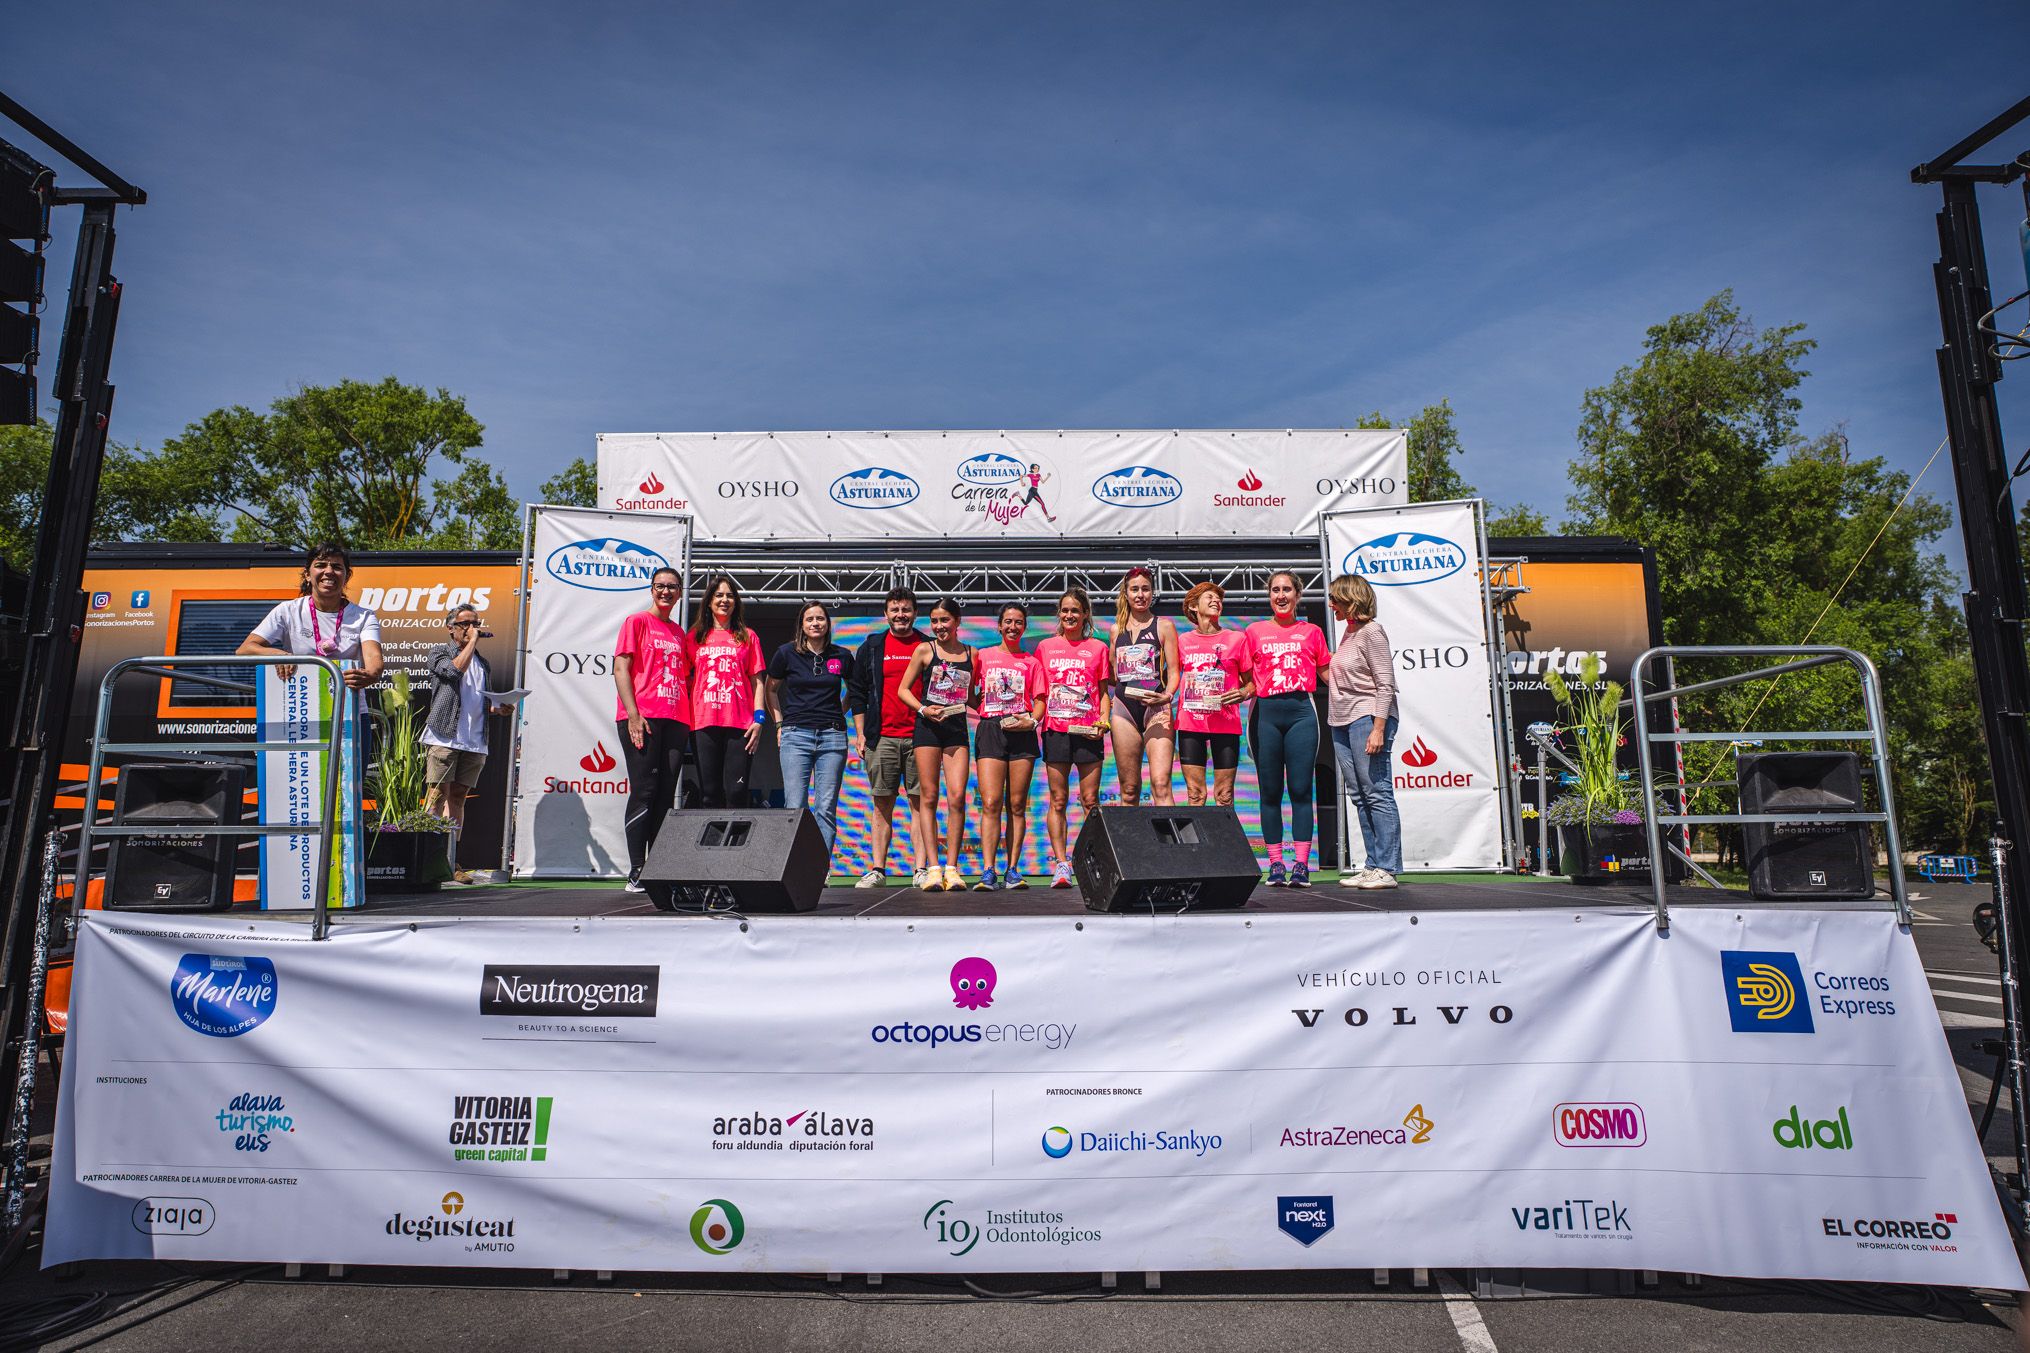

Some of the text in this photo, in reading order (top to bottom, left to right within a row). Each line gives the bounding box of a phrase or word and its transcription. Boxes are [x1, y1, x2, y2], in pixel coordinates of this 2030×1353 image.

[963, 465, 1021, 478] ASTURIANA
[718, 480, 799, 498] OYSHO
[837, 484, 913, 499] ASTURIANA
[951, 483, 1008, 500] Carrera
[1100, 482, 1176, 498] ASTURIANA
[1317, 477, 1396, 496] OYSHO
[616, 498, 688, 510] Santander
[1214, 494, 1286, 507] Santander
[964, 499, 1030, 525] de la Mujer
[575, 553, 615, 563] CENTRAL
[1369, 546, 1452, 558] CENTRAL LECHERA
[1354, 554, 1457, 576] ASTURIANA
[85, 619, 155, 627] onorizacionesPortos
[86, 611, 116, 619] nstagram
[699, 646, 737, 657] CARRERA
[1262, 642, 1302, 654] CARRERA
[545, 652, 615, 675] OYS
[1050, 658, 1086, 669] CARRERA
[1393, 646, 1469, 671] SHO
[1490, 647, 1608, 675] ortos
[703, 690, 732, 703] MUJER
[299, 675, 309, 741] GANADORA
[157, 720, 257, 735] www.sonorizacione
[287, 676, 298, 851] CENTRAL LEHERA ASTURINA
[300, 761, 309, 778] UN
[544, 776, 631, 794] Santand
[1394, 771, 1473, 789] ntander
[300, 780, 309, 809] LOTE
[301, 812, 310, 827] DE
[109, 928, 167, 938] PATROCINADORES
[1297, 969, 1502, 987] VEHÍCULO OFICIAL
[1814, 971, 1890, 991] Correos
[177, 971, 271, 1014] Marlene
[1820, 995, 1896, 1019] Express
[183, 1011, 257, 1034] HIJA DE LOS ALPES
[1291, 1005, 1513, 1028] VOLVO
[518, 1024, 553, 1032] BEAUTY
[579, 1025, 618, 1033] SCIENCE
[871, 1021, 1077, 1050] octopus energy
[96, 1076, 148, 1085] INSTITUCIONES
[1046, 1088, 1111, 1096] PATROCINADORES
[229, 1092, 285, 1112] alava
[454, 1096, 532, 1119] VITORIA
[713, 1111, 873, 1136] araba álava
[1560, 1108, 1637, 1140] COSMO
[1772, 1104, 1853, 1150] dial
[449, 1121, 531, 1145] GASTEIZ
[1280, 1127, 1406, 1147] AstraZeneca
[235, 1133, 271, 1152] eus
[712, 1140, 873, 1152] foru aldundia diputación foral
[1080, 1129, 1222, 1157] Daiichi-Sankyo
[454, 1147, 528, 1162] green capital
[83, 1174, 149, 1182] PATROCINADORES
[149, 1174, 180, 1183] CARRERA
[202, 1176, 226, 1184] MUJER
[237, 1177, 298, 1185] VITORIA-GASTEIZ
[143, 1207, 203, 1231] ziaja
[986, 1209, 1063, 1225] Institutos
[1285, 1208, 1326, 1222] next
[1511, 1200, 1631, 1231] variTek
[385, 1212, 516, 1242] degusteat
[986, 1226, 1102, 1245] Odontológicos
[1822, 1218, 1952, 1240] EL CORREO
[474, 1243, 515, 1252] AMUTIO
[1857, 1241, 1910, 1251] INFORMACIÓN
[1929, 1245, 1958, 1253] VALOR
